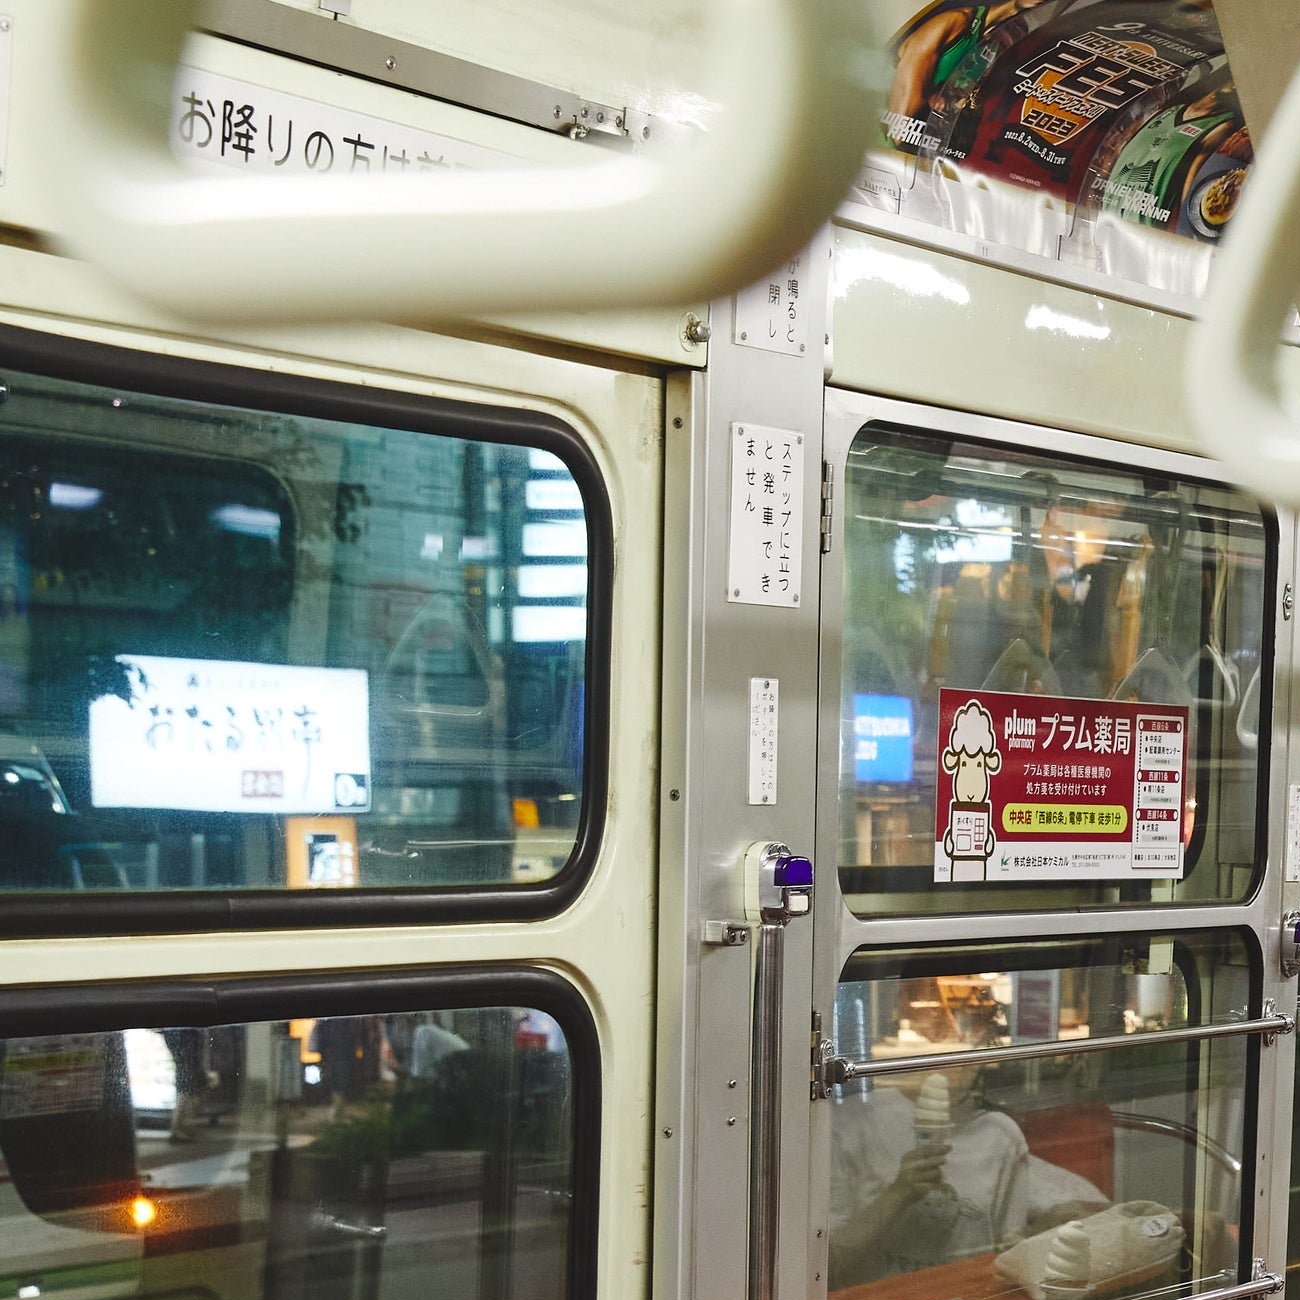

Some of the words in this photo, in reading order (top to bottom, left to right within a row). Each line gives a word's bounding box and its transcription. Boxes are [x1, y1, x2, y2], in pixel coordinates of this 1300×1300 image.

[1015, 41, 1165, 109] FES
[1021, 108, 1079, 138] 2023
[744, 438, 757, 512] ません
[761, 440, 775, 593] と発車でき
[778, 443, 792, 593] ステップに立つ
[1004, 709, 1036, 739] plum
[1041, 713, 1131, 755] プラム薬局
[1023, 763, 1112, 779] プラム薬局は各種医療機関の
[1014, 856, 1069, 867] 株式会社日本ケミカル
